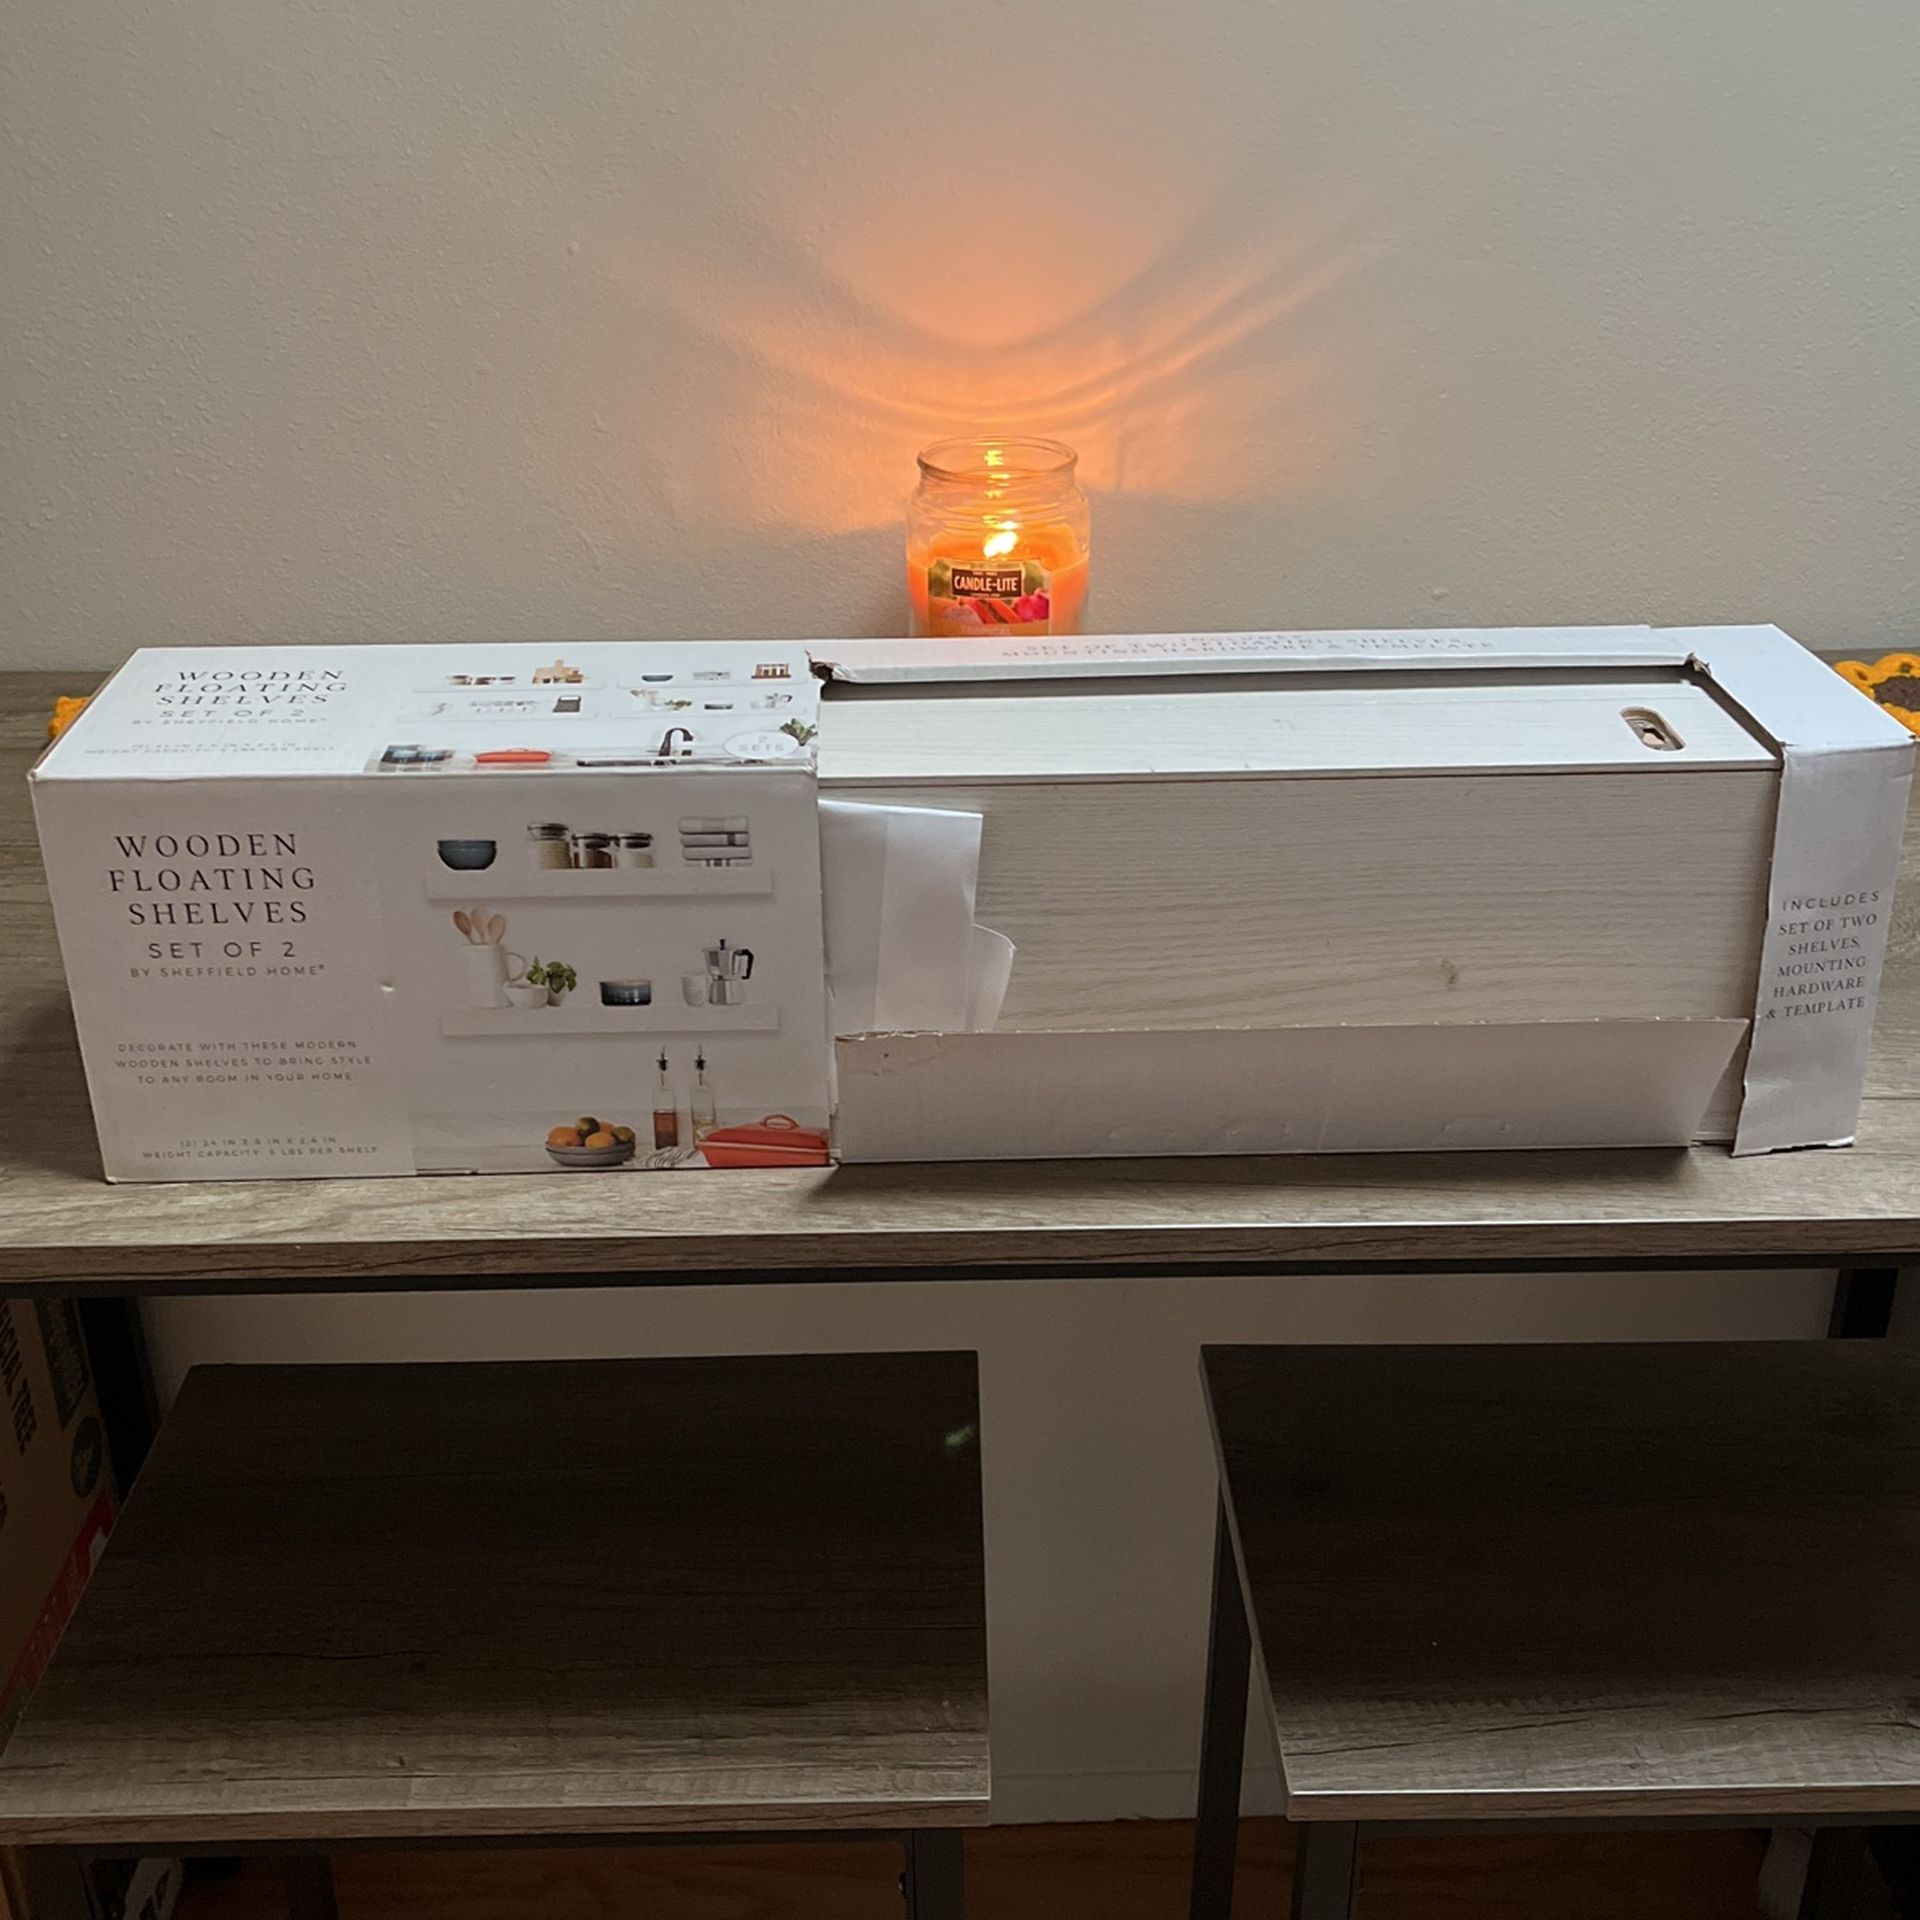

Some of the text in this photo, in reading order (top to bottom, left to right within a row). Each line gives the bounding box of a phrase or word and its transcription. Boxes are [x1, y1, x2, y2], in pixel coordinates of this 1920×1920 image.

[954, 575, 1019, 591] CANDLE-LITE
[178, 670, 344, 681] WOODEN
[155, 682, 348, 693] FLOATING
[156, 694, 328, 705] SHELVES
[160, 709, 305, 718] SET OF 2
[114, 834, 297, 857] WOODEN
[108, 867, 315, 892] FLOATING
[1782, 890, 1879, 911] INCLUDES
[128, 901, 307, 925] SHELVES
[1778, 913, 1877, 936] SET OF TWO
[149, 941, 296, 959] SET OF 2
[130, 969, 149, 978] BY
[160, 966, 257, 977] SHEFFIELD
[1777, 956, 1866, 978] MOUNTING
[1774, 976, 1865, 998] HARDWARE
[1766, 996, 1865, 1019] & TEMPLATE
[117, 1040, 357, 1053] DECORATE WITH THESE MODERN
[114, 1056, 372, 1069] WOODEN SHELVES TO BRING STYLE
[137, 1075, 155, 1084] TO
[161, 1075, 189, 1084] ANY
[196, 1074, 238, 1083] ROOM
[245, 1074, 259, 1082] IN
[266, 1073, 304, 1082] YOUR
[142, 1151, 191, 1159] WEIGHT
[339, 1146, 377, 1154] SHELF
